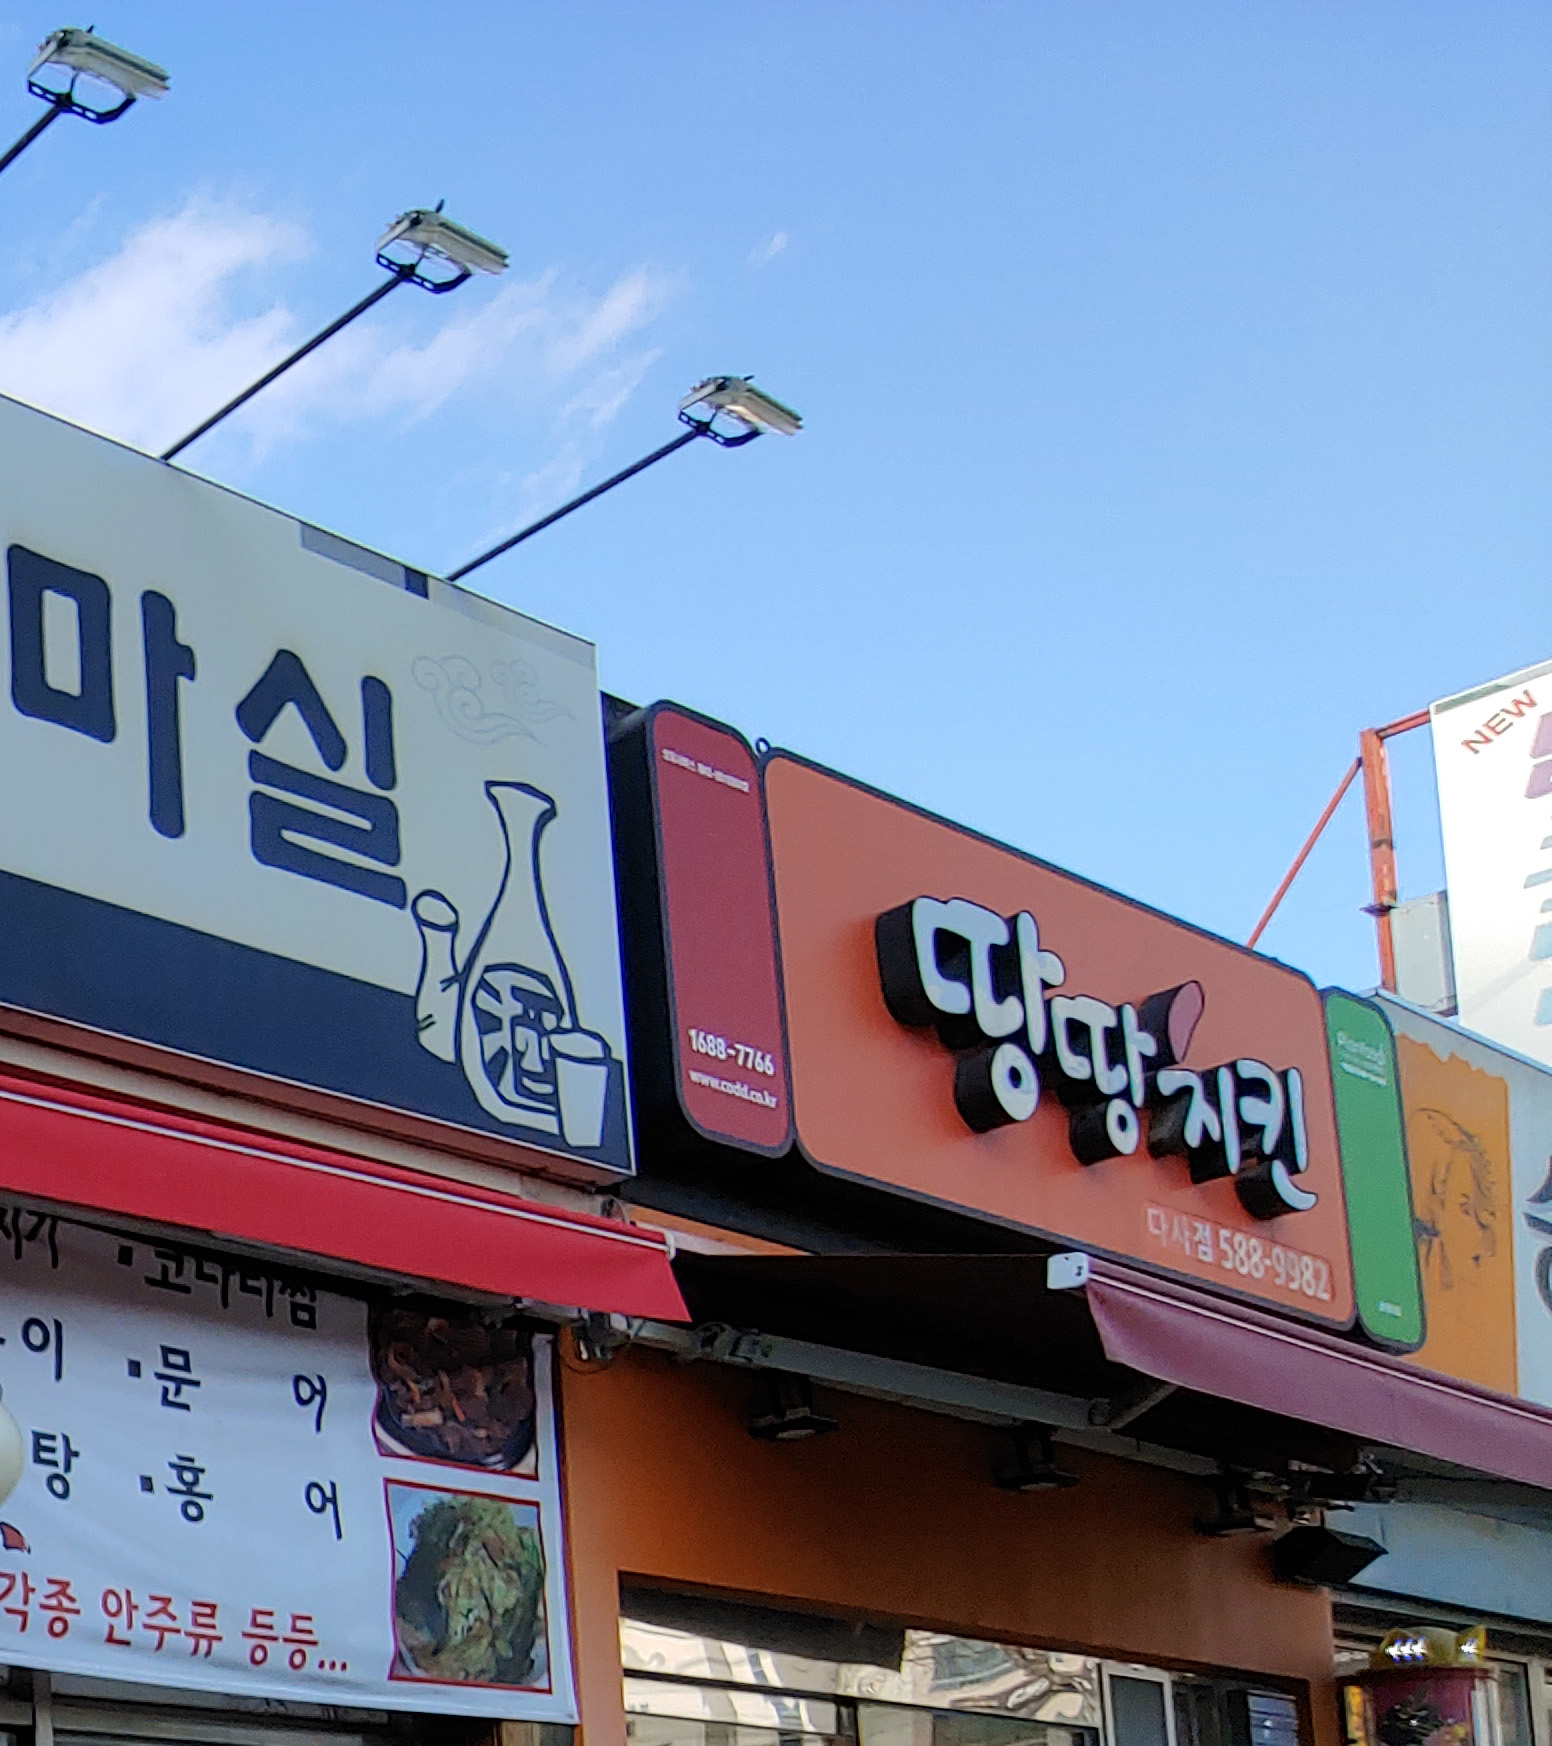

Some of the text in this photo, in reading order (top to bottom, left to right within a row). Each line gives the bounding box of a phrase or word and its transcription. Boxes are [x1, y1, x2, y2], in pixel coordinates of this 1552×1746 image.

[1461, 689, 1538, 755] NEW
[688, 1028, 775, 1076] 1688-7766
[1147, 1207, 1331, 1301] 다사점 588-9982
[100, 1588, 223, 1660] 안주류
[242, 1611, 351, 1675] 등등...
